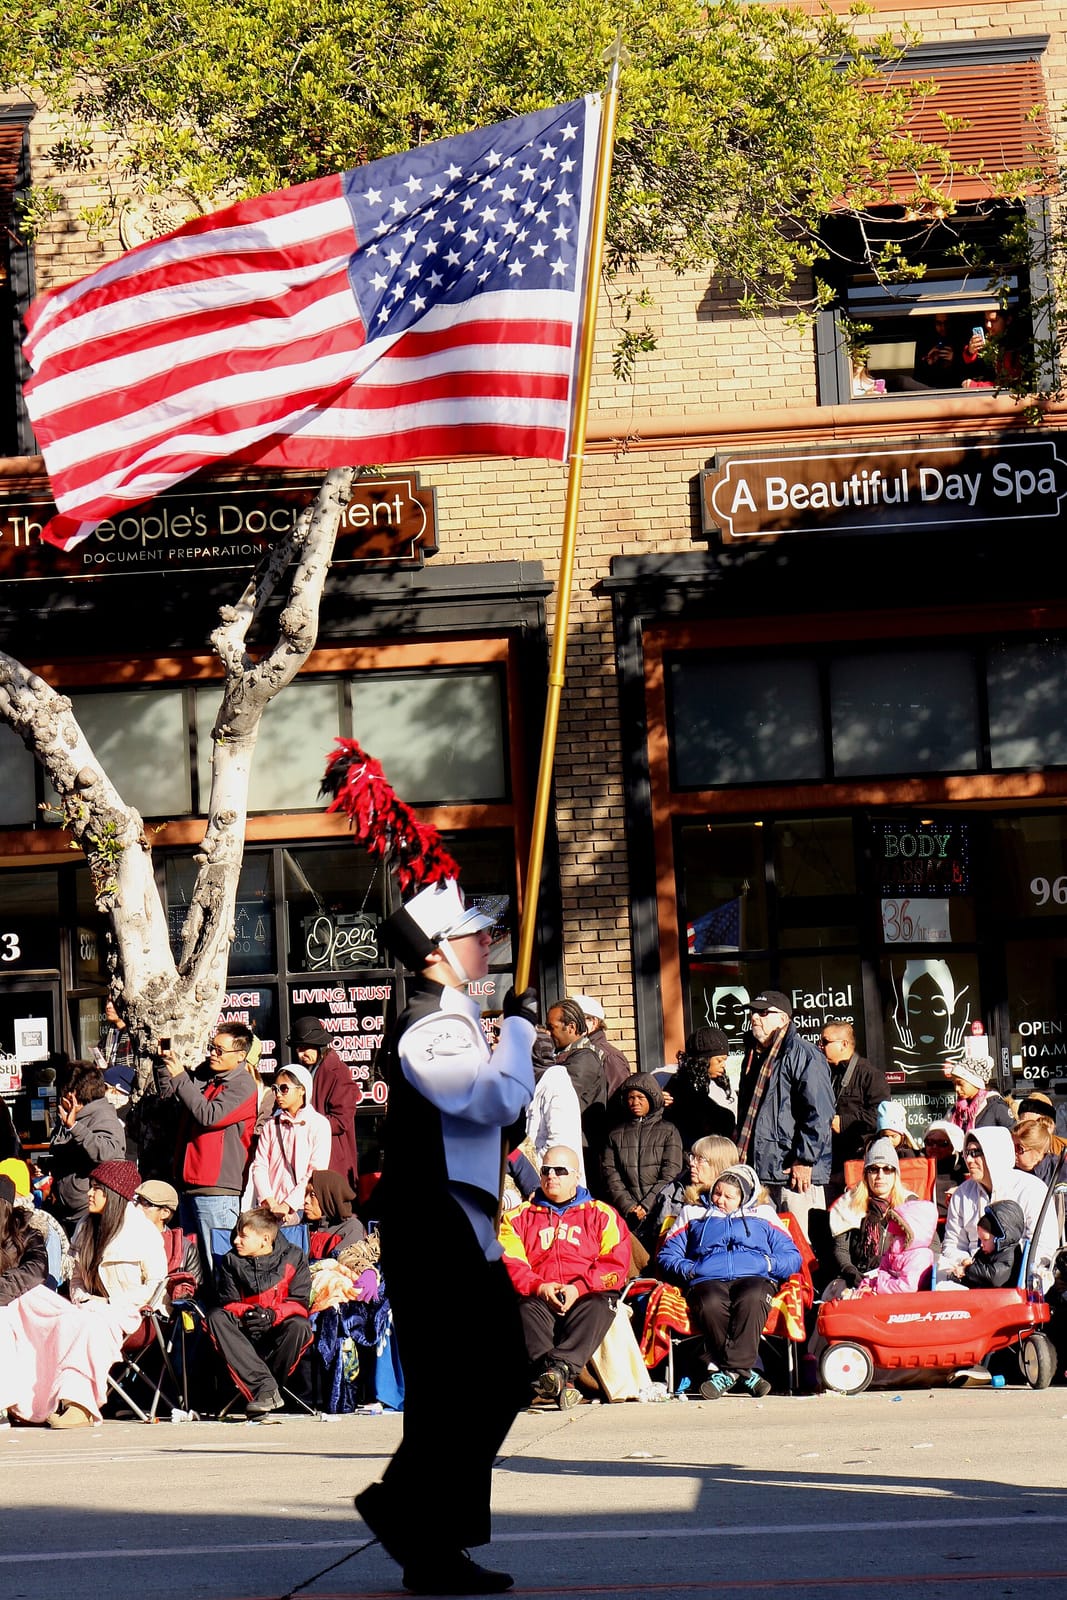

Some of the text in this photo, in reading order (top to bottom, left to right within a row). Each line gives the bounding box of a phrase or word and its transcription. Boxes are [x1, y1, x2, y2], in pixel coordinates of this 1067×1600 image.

[731, 463, 1057, 513] A Beautiful Day Spa
[8, 515, 45, 547] Th
[95, 506, 208, 547] eople's
[83, 549, 163, 564] DOCUMENT
[168, 543, 262, 559] PREPARATION
[884, 833, 951, 858] BODY
[307, 917, 377, 968] Open
[293, 986, 391, 1004] LIVING TRUST
[468, 981, 496, 996] LLC
[791, 984, 853, 1009] Facial
[221, 992, 260, 1008] ORCE
[330, 1002, 356, 1014] WILL
[217, 1011, 249, 1026] AME
[319, 1016, 384, 1032] WER OF
[793, 1015, 820, 1028] Skin
[1018, 1021, 1062, 1036] OPEN
[329, 1034, 384, 1050] ORNEY
[1020, 1045, 1037, 1057] 10
[538, 1219, 582, 1251] USC
